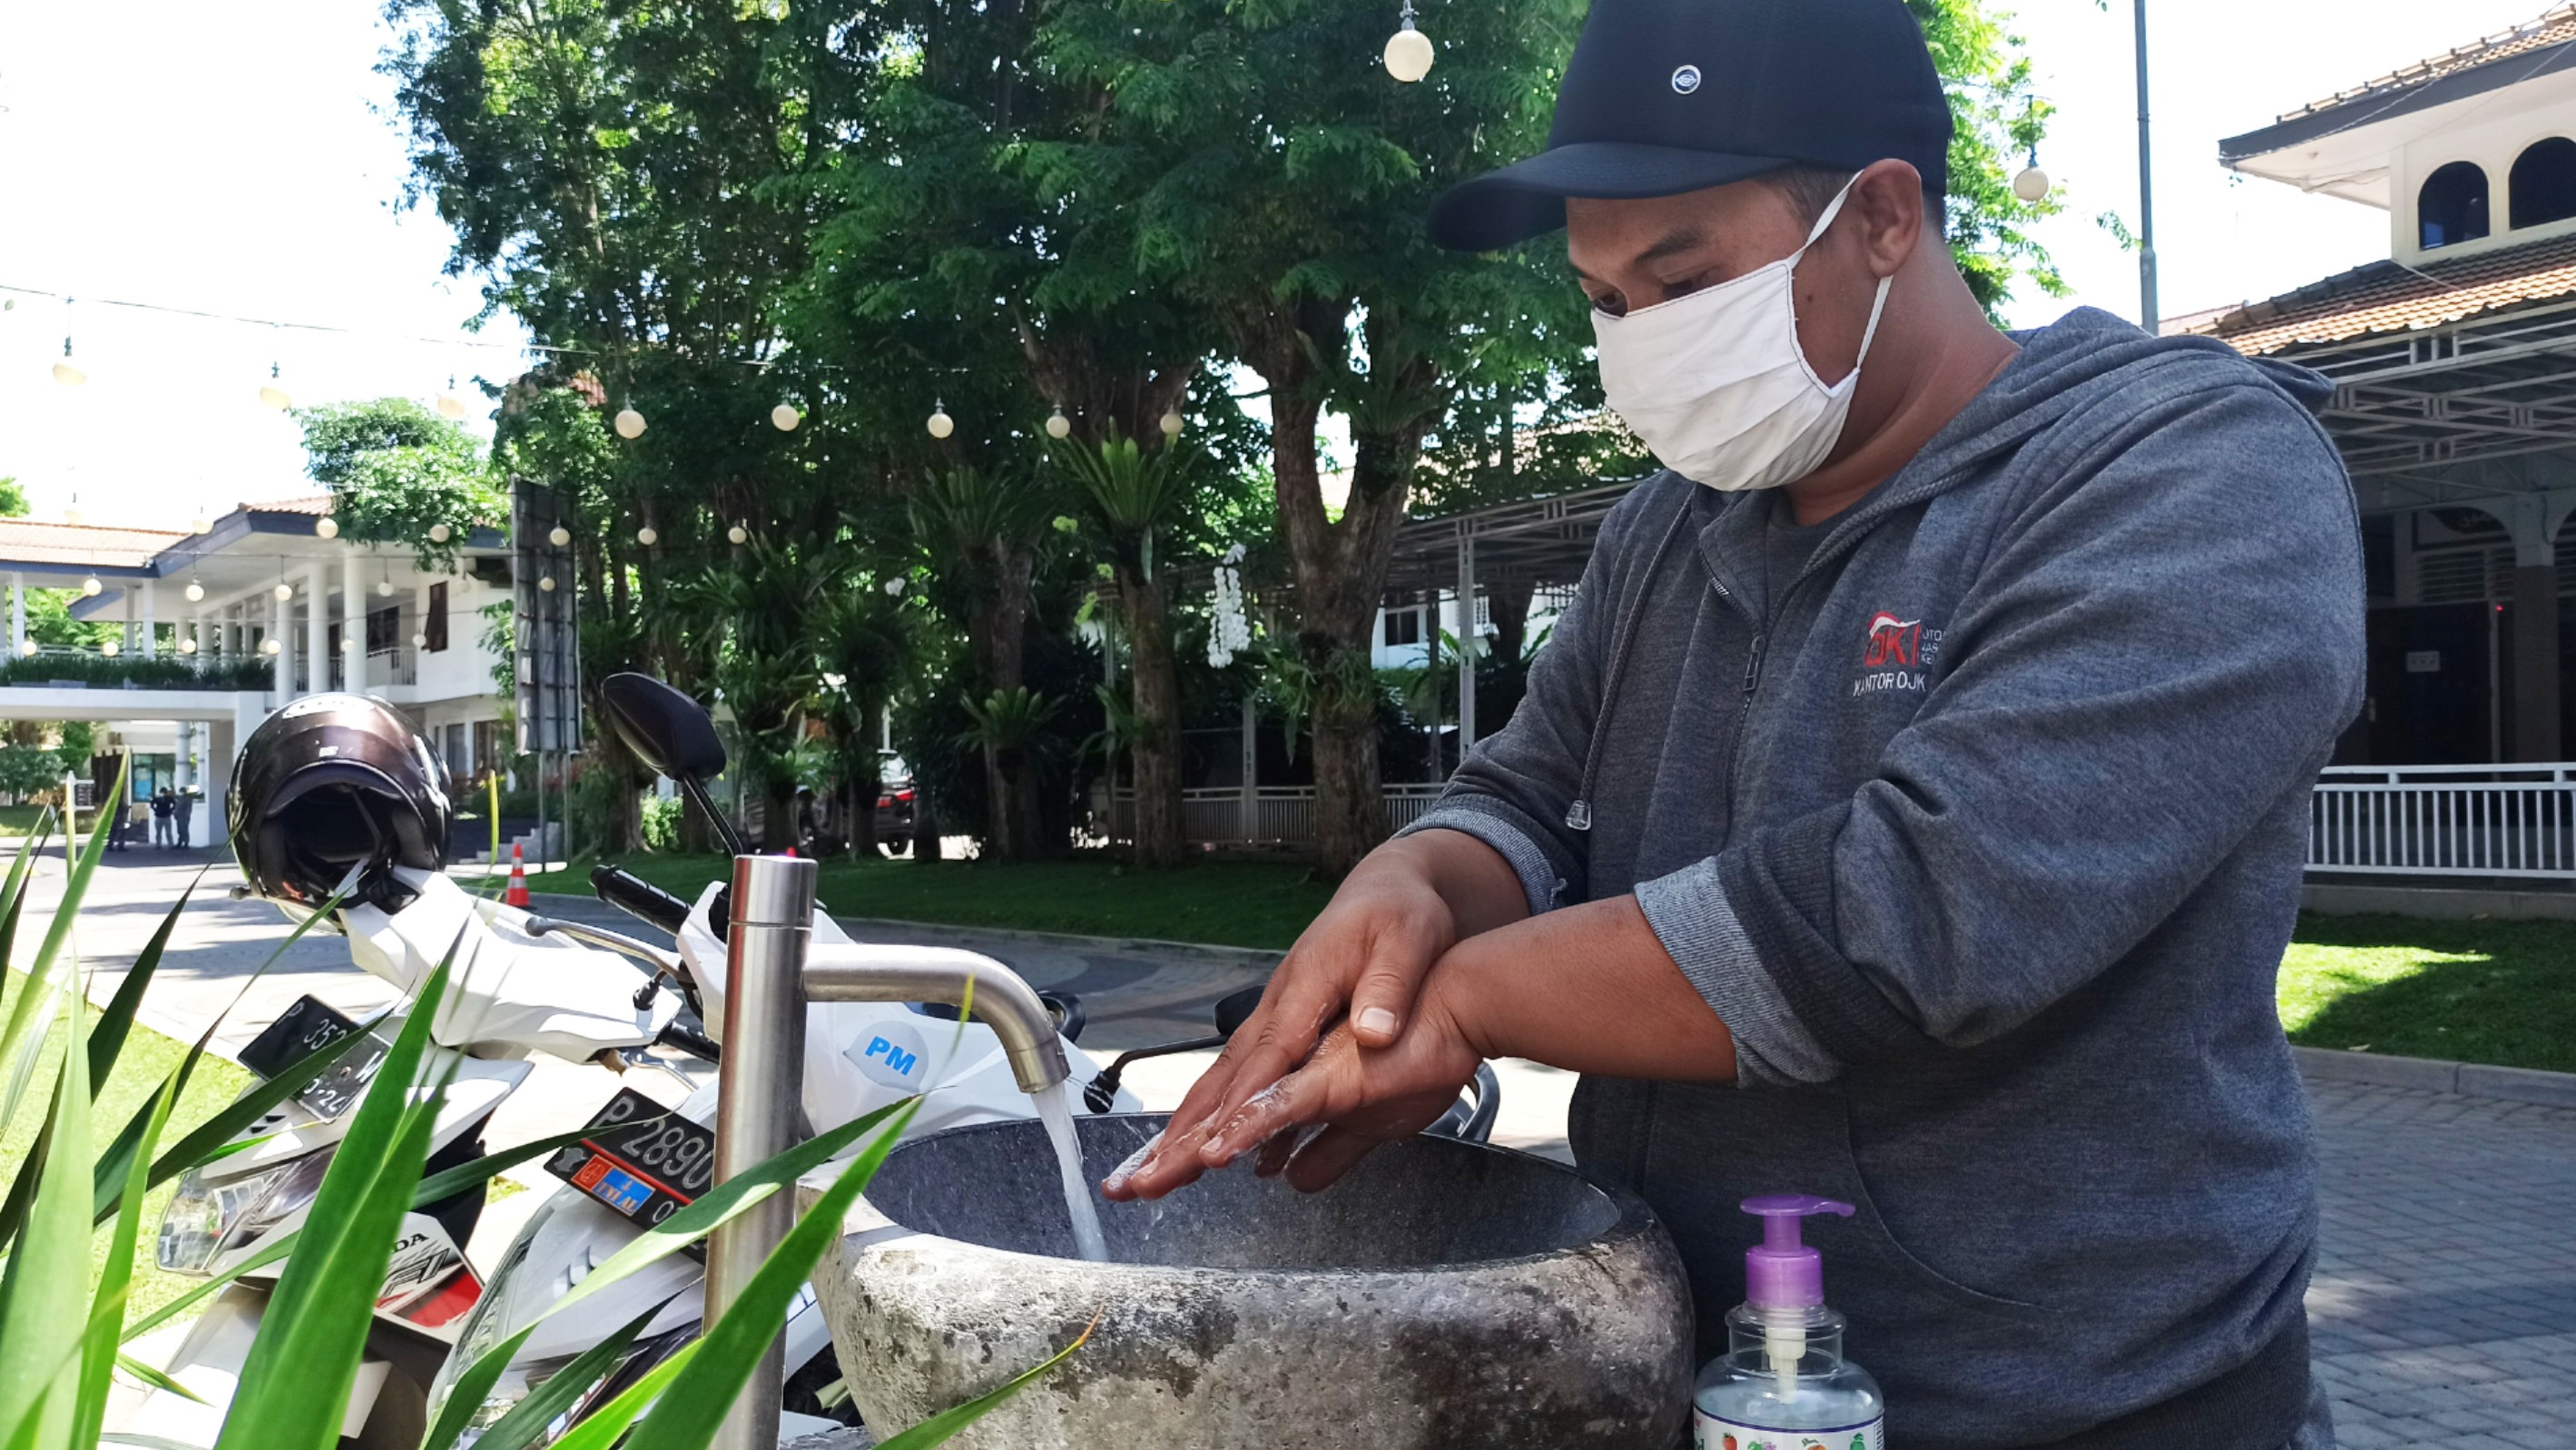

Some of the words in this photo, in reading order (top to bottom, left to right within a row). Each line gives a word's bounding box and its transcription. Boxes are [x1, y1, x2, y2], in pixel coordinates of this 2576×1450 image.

[1853, 672, 1894, 697] KANTOR
[1896, 671, 1926, 692] OJK
[276, 1001, 305, 1026] P
[865, 1036, 917, 1076] PM
[592, 1096, 635, 1129] P
[621, 1119, 713, 1189] 2890
